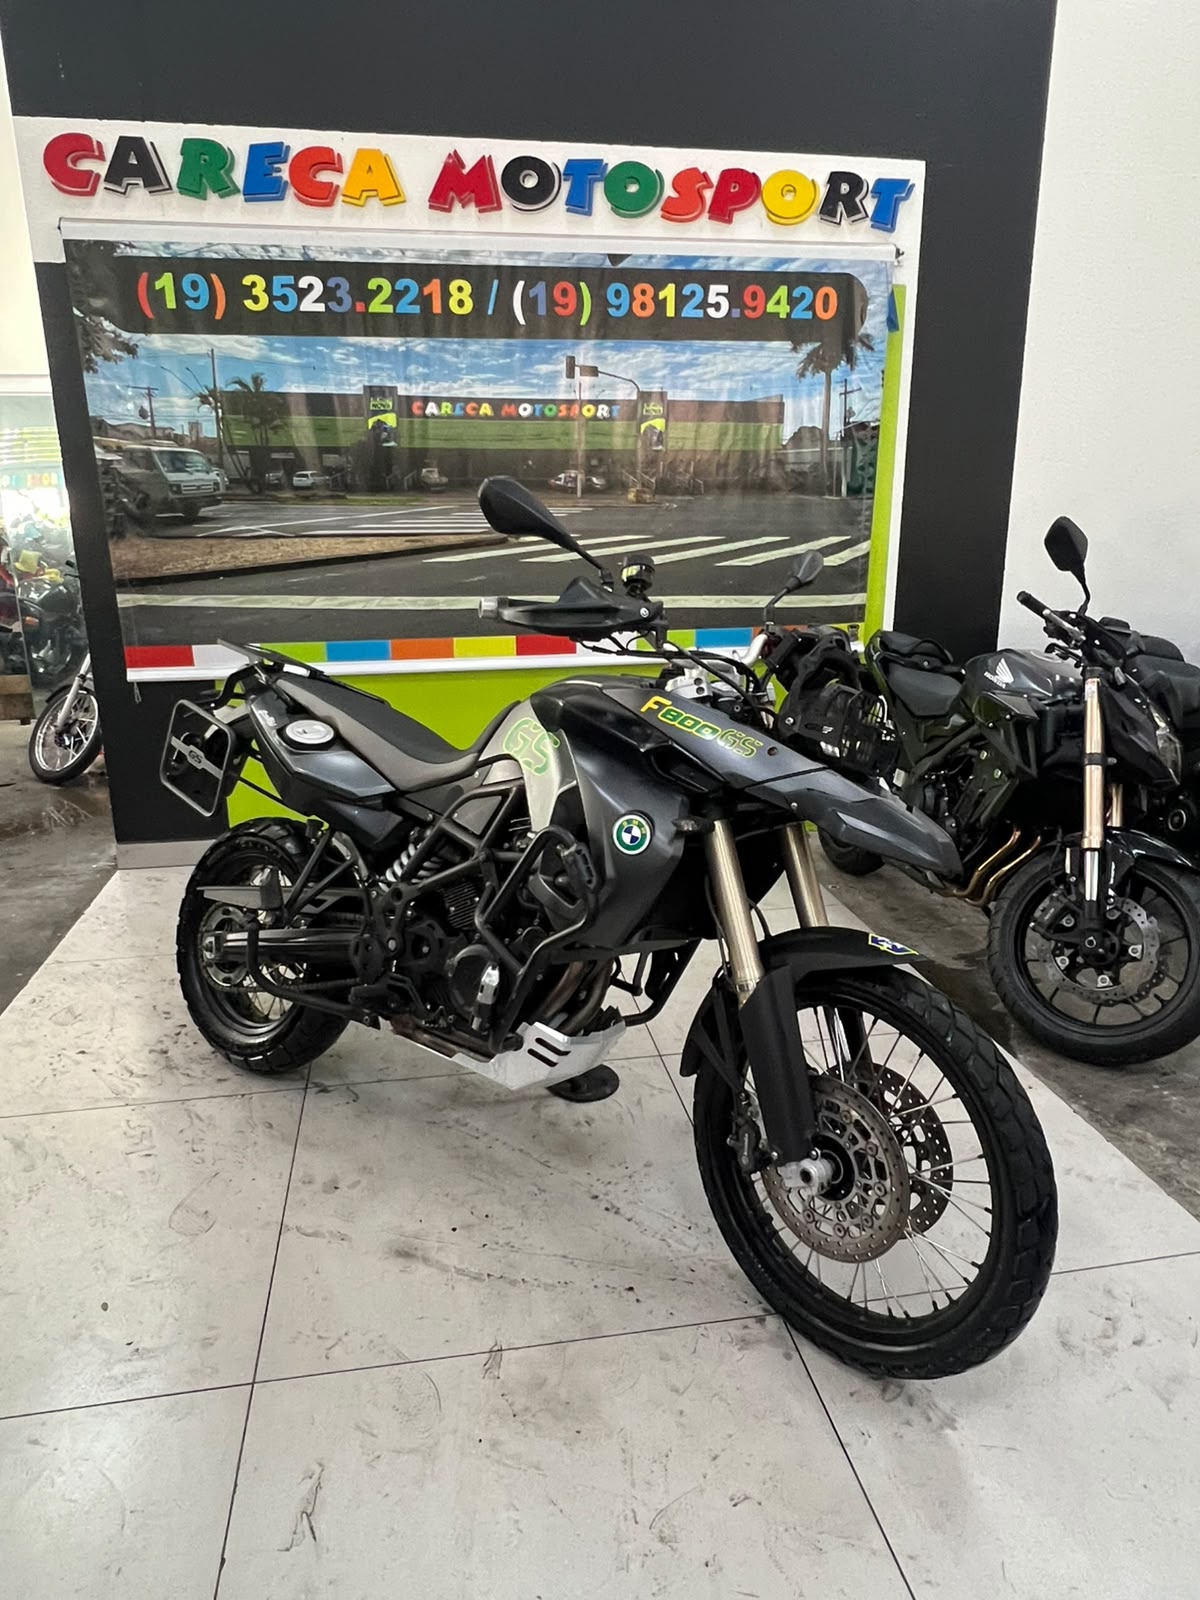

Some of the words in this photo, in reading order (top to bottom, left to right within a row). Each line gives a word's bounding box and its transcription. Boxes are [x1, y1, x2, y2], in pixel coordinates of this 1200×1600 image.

[43, 132, 406, 207] CARECA
[427, 149, 915, 233] MOTOSPORT
[137, 272, 226, 320] (19)
[242, 274, 474, 315] 3523.2218
[512, 280, 592, 326] (19)
[606, 282, 838, 320] 98125.9420
[411, 400, 494, 417] CARECA
[501, 402, 621, 419] MOTOSPORT
[188, 750, 203, 764] GS
